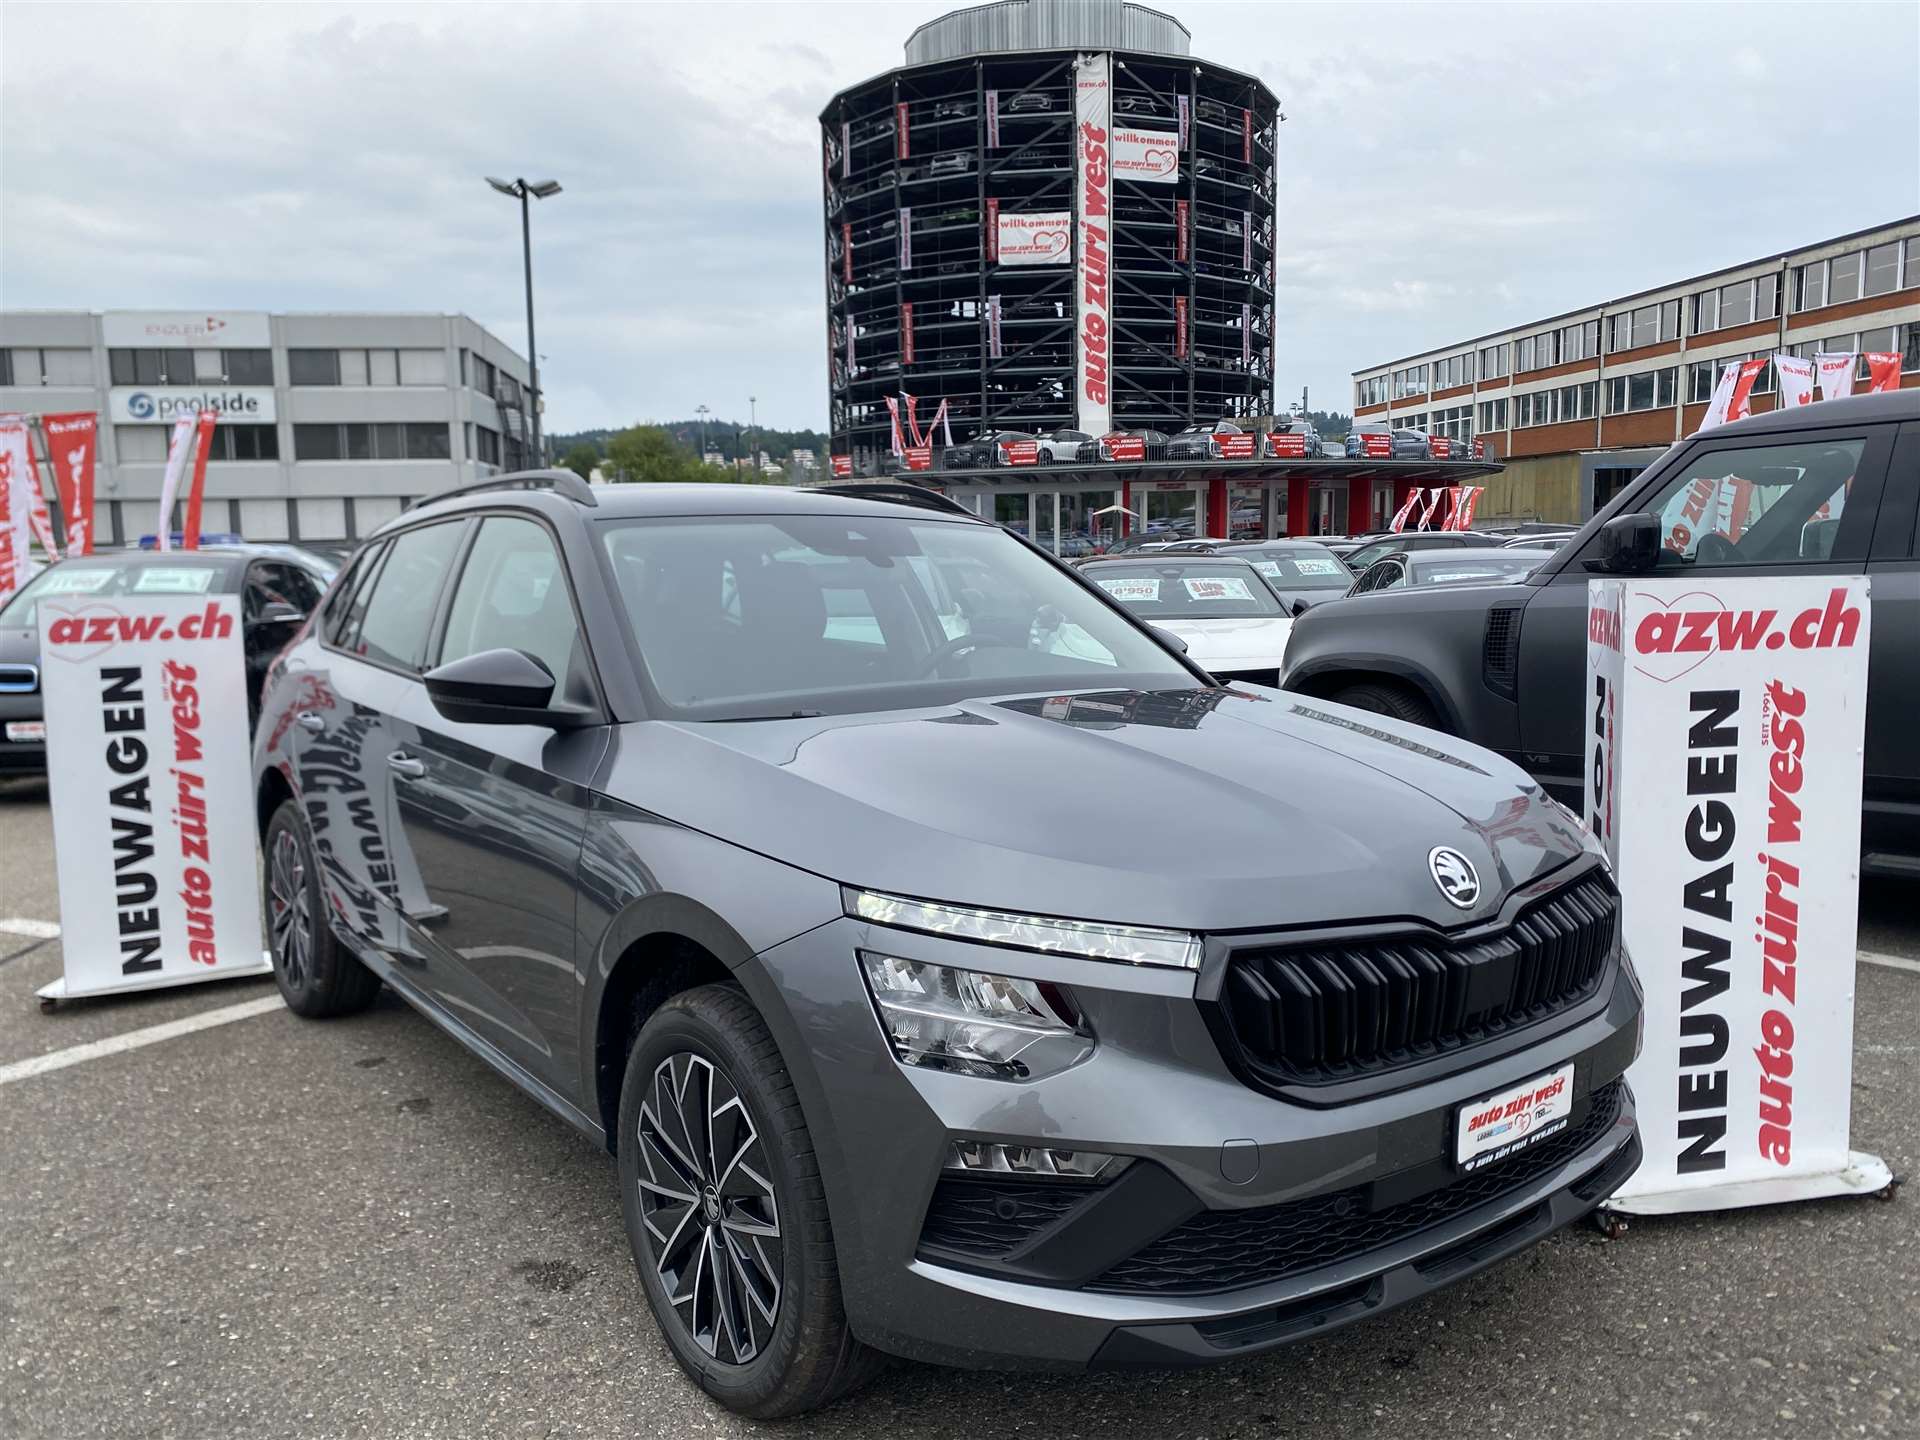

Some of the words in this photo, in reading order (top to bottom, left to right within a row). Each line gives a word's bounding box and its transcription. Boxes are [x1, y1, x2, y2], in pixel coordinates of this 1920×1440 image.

[1078, 80, 1107, 88] azw.ch
[1081, 121, 1107, 216] west
[1114, 133, 1177, 147] willkommen
[1000, 219, 1069, 228] willkommen
[1079, 221, 1107, 311] züri
[1080, 313, 1107, 405] auto
[158, 392, 258, 419] poolside
[48, 602, 234, 645] azw.ch
[1635, 588, 1861, 654] azw.ch
[163, 660, 203, 762] west
[1761, 723, 1769, 746] SEIT
[1762, 693, 1770, 718] 1991
[1765, 679, 1806, 843] west
[100, 666, 163, 976] NEUWAGEN
[169, 768, 211, 864] züri
[178, 867, 216, 967] auto
[1677, 689, 1740, 1174] NEUWAGEN
[1754, 852, 1800, 1006] züri
[1468, 1106, 1503, 1132] auto
[1504, 1089, 1535, 1118] züri
[1535, 1077, 1566, 1103] west
[1752, 1010, 1795, 1166] auto
[1475, 1154, 1494, 1168] auto
[1494, 1145, 1511, 1160] züri
